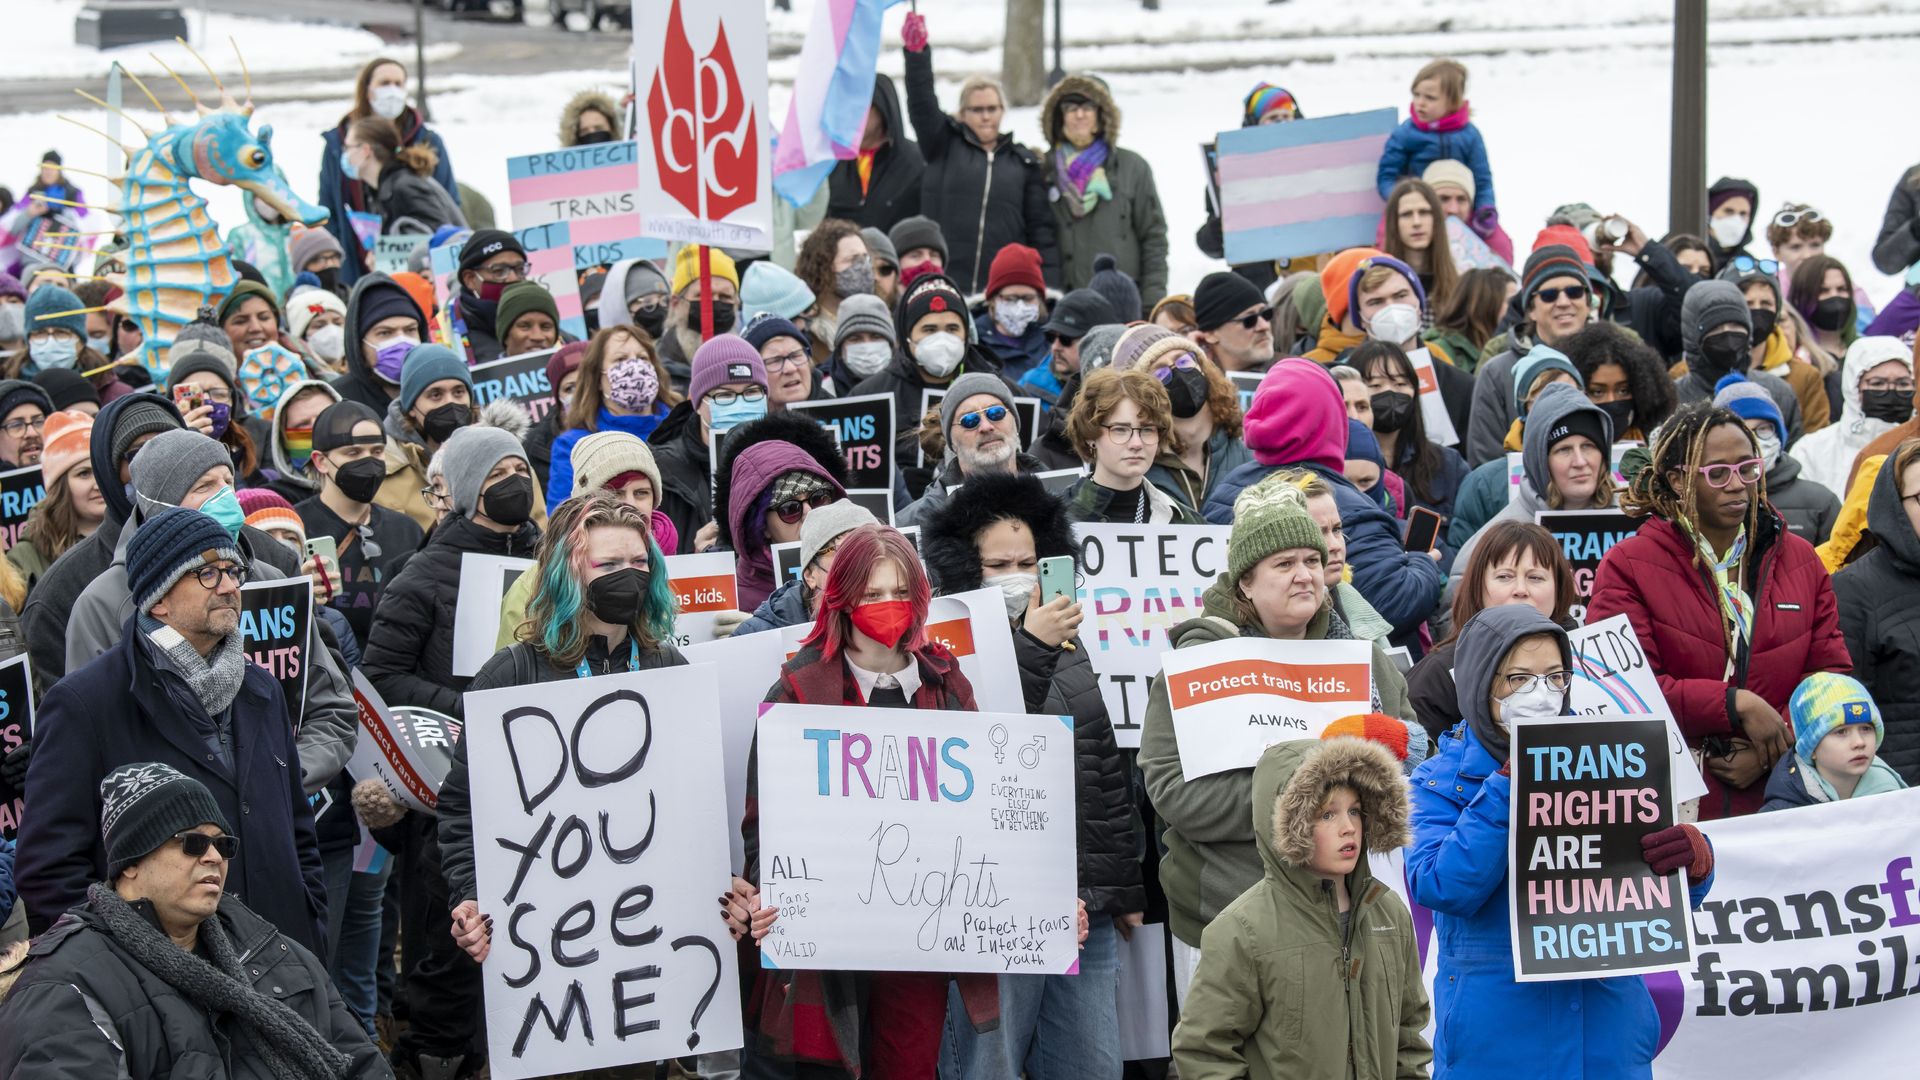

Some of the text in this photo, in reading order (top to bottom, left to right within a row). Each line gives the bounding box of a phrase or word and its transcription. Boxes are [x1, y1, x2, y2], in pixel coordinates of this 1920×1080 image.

[528, 141, 637, 175] PROTECT
[550, 193, 634, 221] TRANS
[574, 242, 624, 264] KIDS
[694, 590, 726, 606] kids.
[1570, 623, 1644, 681] KIDS
[1188, 672, 1351, 697] Protect trans kids.
[409, 713, 449, 749] ARE
[1248, 713, 1309, 731] ALWAYS
[501, 689, 653, 816] DO
[803, 728, 975, 803] TRANS
[1526, 743, 1647, 782] TRANS
[391, 752, 418, 791] trans
[1000, 775, 1018, 783] and
[991, 783, 1047, 800] EVERYTHING
[991, 808, 1049, 823] EVERYTHING
[1528, 788, 1660, 827] RIGHTS
[994, 819, 1045, 832] IN BETWEEN
[495, 788, 656, 906] YOU
[1528, 834, 1602, 871] ARE
[771, 855, 823, 882] ALL
[763, 882, 810, 904] Trans
[858, 820, 1010, 952] Rights
[1527, 875, 1672, 915] HUMAN
[768, 925, 785, 936] are
[963, 912, 1018, 935] Protect
[771, 940, 818, 958] VALID
[944, 935, 1046, 954] and Intersex
[1532, 919, 1683, 960] RIGHTS.
[1002, 953, 1045, 971] youth
